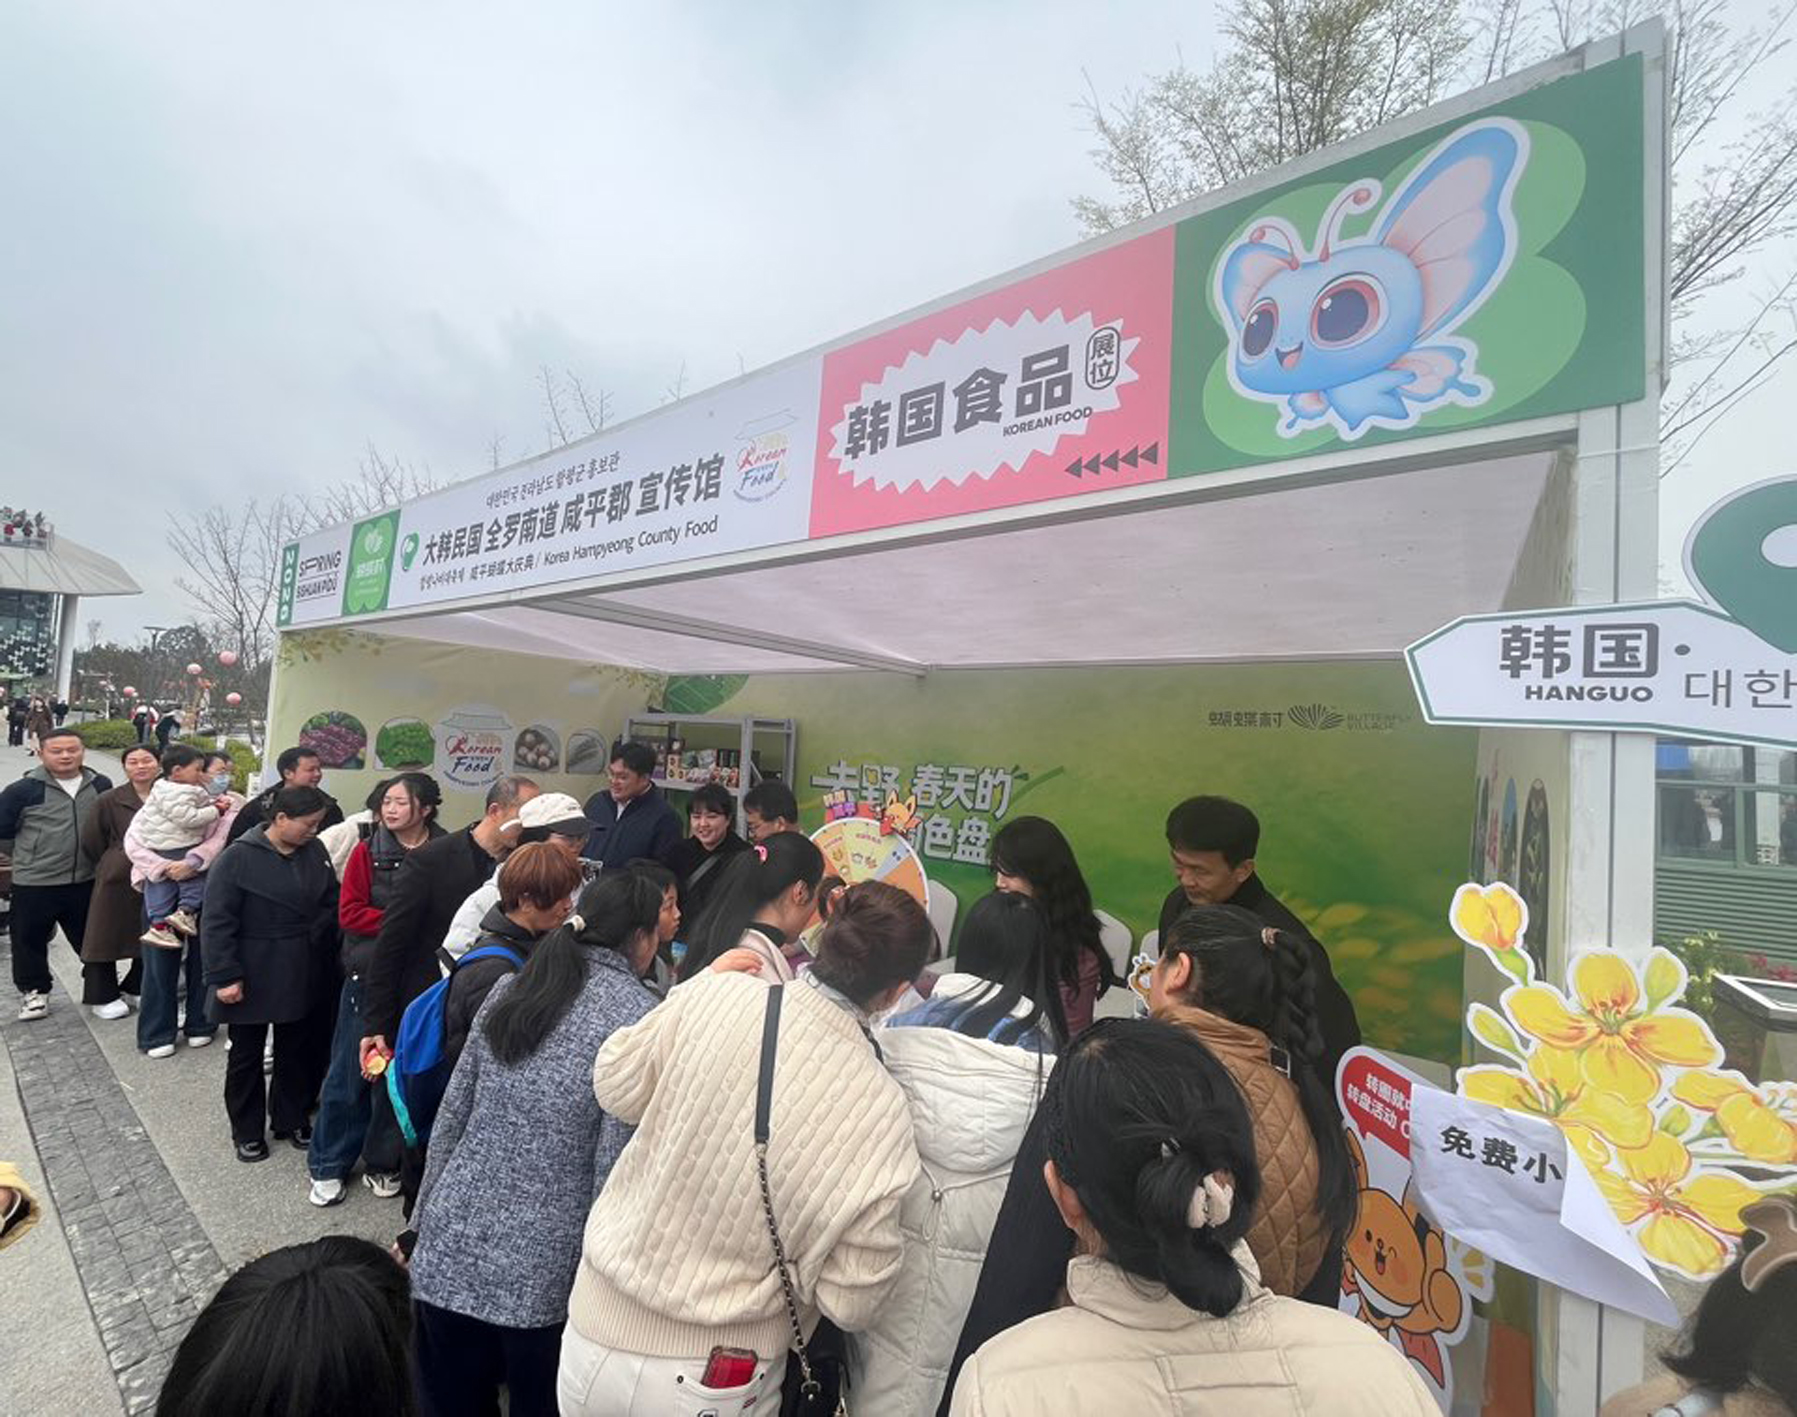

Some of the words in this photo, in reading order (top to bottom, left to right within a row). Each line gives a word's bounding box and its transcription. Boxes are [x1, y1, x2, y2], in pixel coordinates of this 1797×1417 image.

[1089, 333, 1115, 386] 展位
[844, 344, 1073, 460] 韩国食品
[1003, 414, 1053, 437] KOREAN
[1055, 406, 1094, 428] FOOD
[422, 521, 484, 566] 大韩民国
[484, 500, 559, 553] 全罗南道
[560, 480, 634, 535] 咸平郡
[635, 452, 725, 517] 宣传馆
[543, 550, 570, 566] Korea
[572, 536, 635, 560] Hampyeong
[638, 525, 681, 548] County
[685, 514, 719, 539] Food
[1524, 684, 1654, 703] HANGUO
[446, 731, 502, 755] Korean
[451, 755, 495, 774] Food
[912, 764, 1014, 822] 春天的
[1439, 1125, 1563, 1184] 免费小
